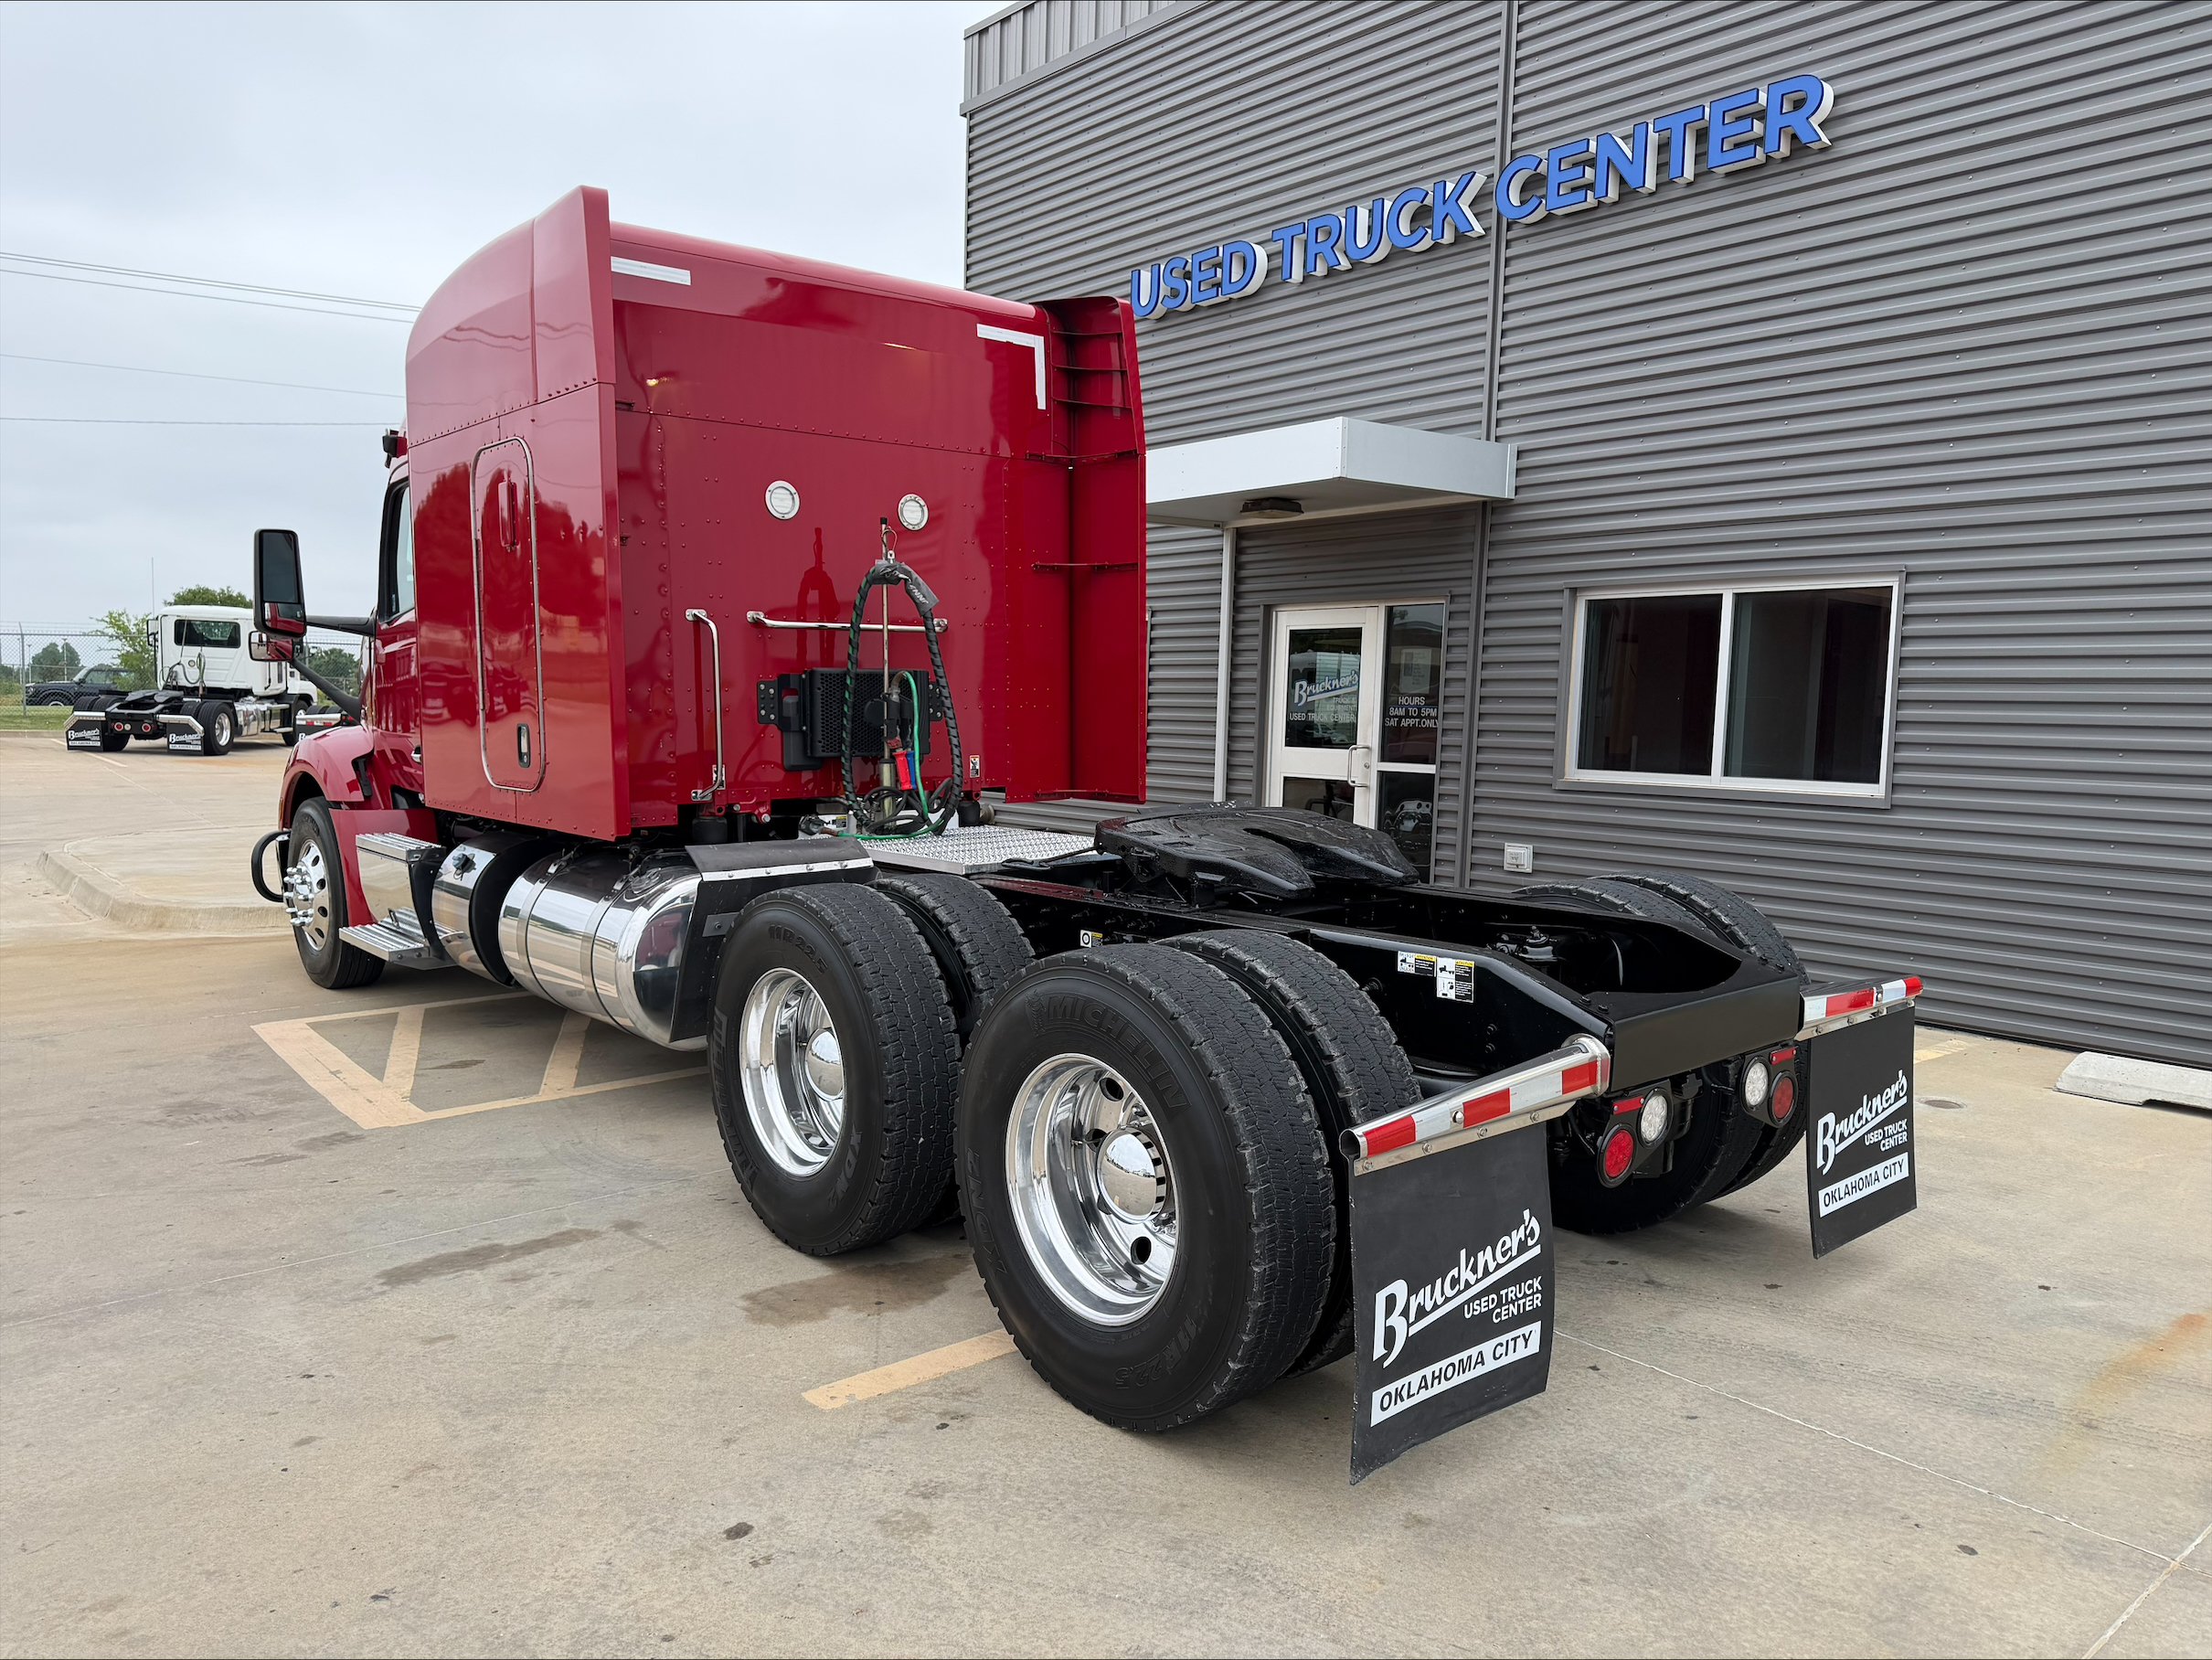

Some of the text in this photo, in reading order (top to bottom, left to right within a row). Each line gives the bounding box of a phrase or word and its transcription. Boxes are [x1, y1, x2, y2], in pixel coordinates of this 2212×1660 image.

[1131, 73, 1834, 319] USED TRUCK CENTER
[1293, 669, 1359, 707] Bruckner's
[1398, 697, 1426, 706] HOURS
[1308, 713, 1328, 721] TRUCK
[1330, 713, 1356, 722] CENTER
[1385, 718, 1398, 727] SAT
[1389, 707, 1437, 717] 8AM TO 5PM
[1048, 994, 1188, 1110] MICHELIN
[1816, 1069, 1908, 1176] Bruckner's
[1864, 1118, 1909, 1146] USED TRUCK
[1880, 1133, 1909, 1153] CENTER
[1823, 1158, 1906, 1208] OKLAHOMA CITY
[1372, 1208, 1542, 1369] Bruckner's
[1463, 1276, 1543, 1320] USED TRUCK
[1492, 1294, 1543, 1325] CENTER
[1378, 1329, 1534, 1413] OKLAHOMA CITY
